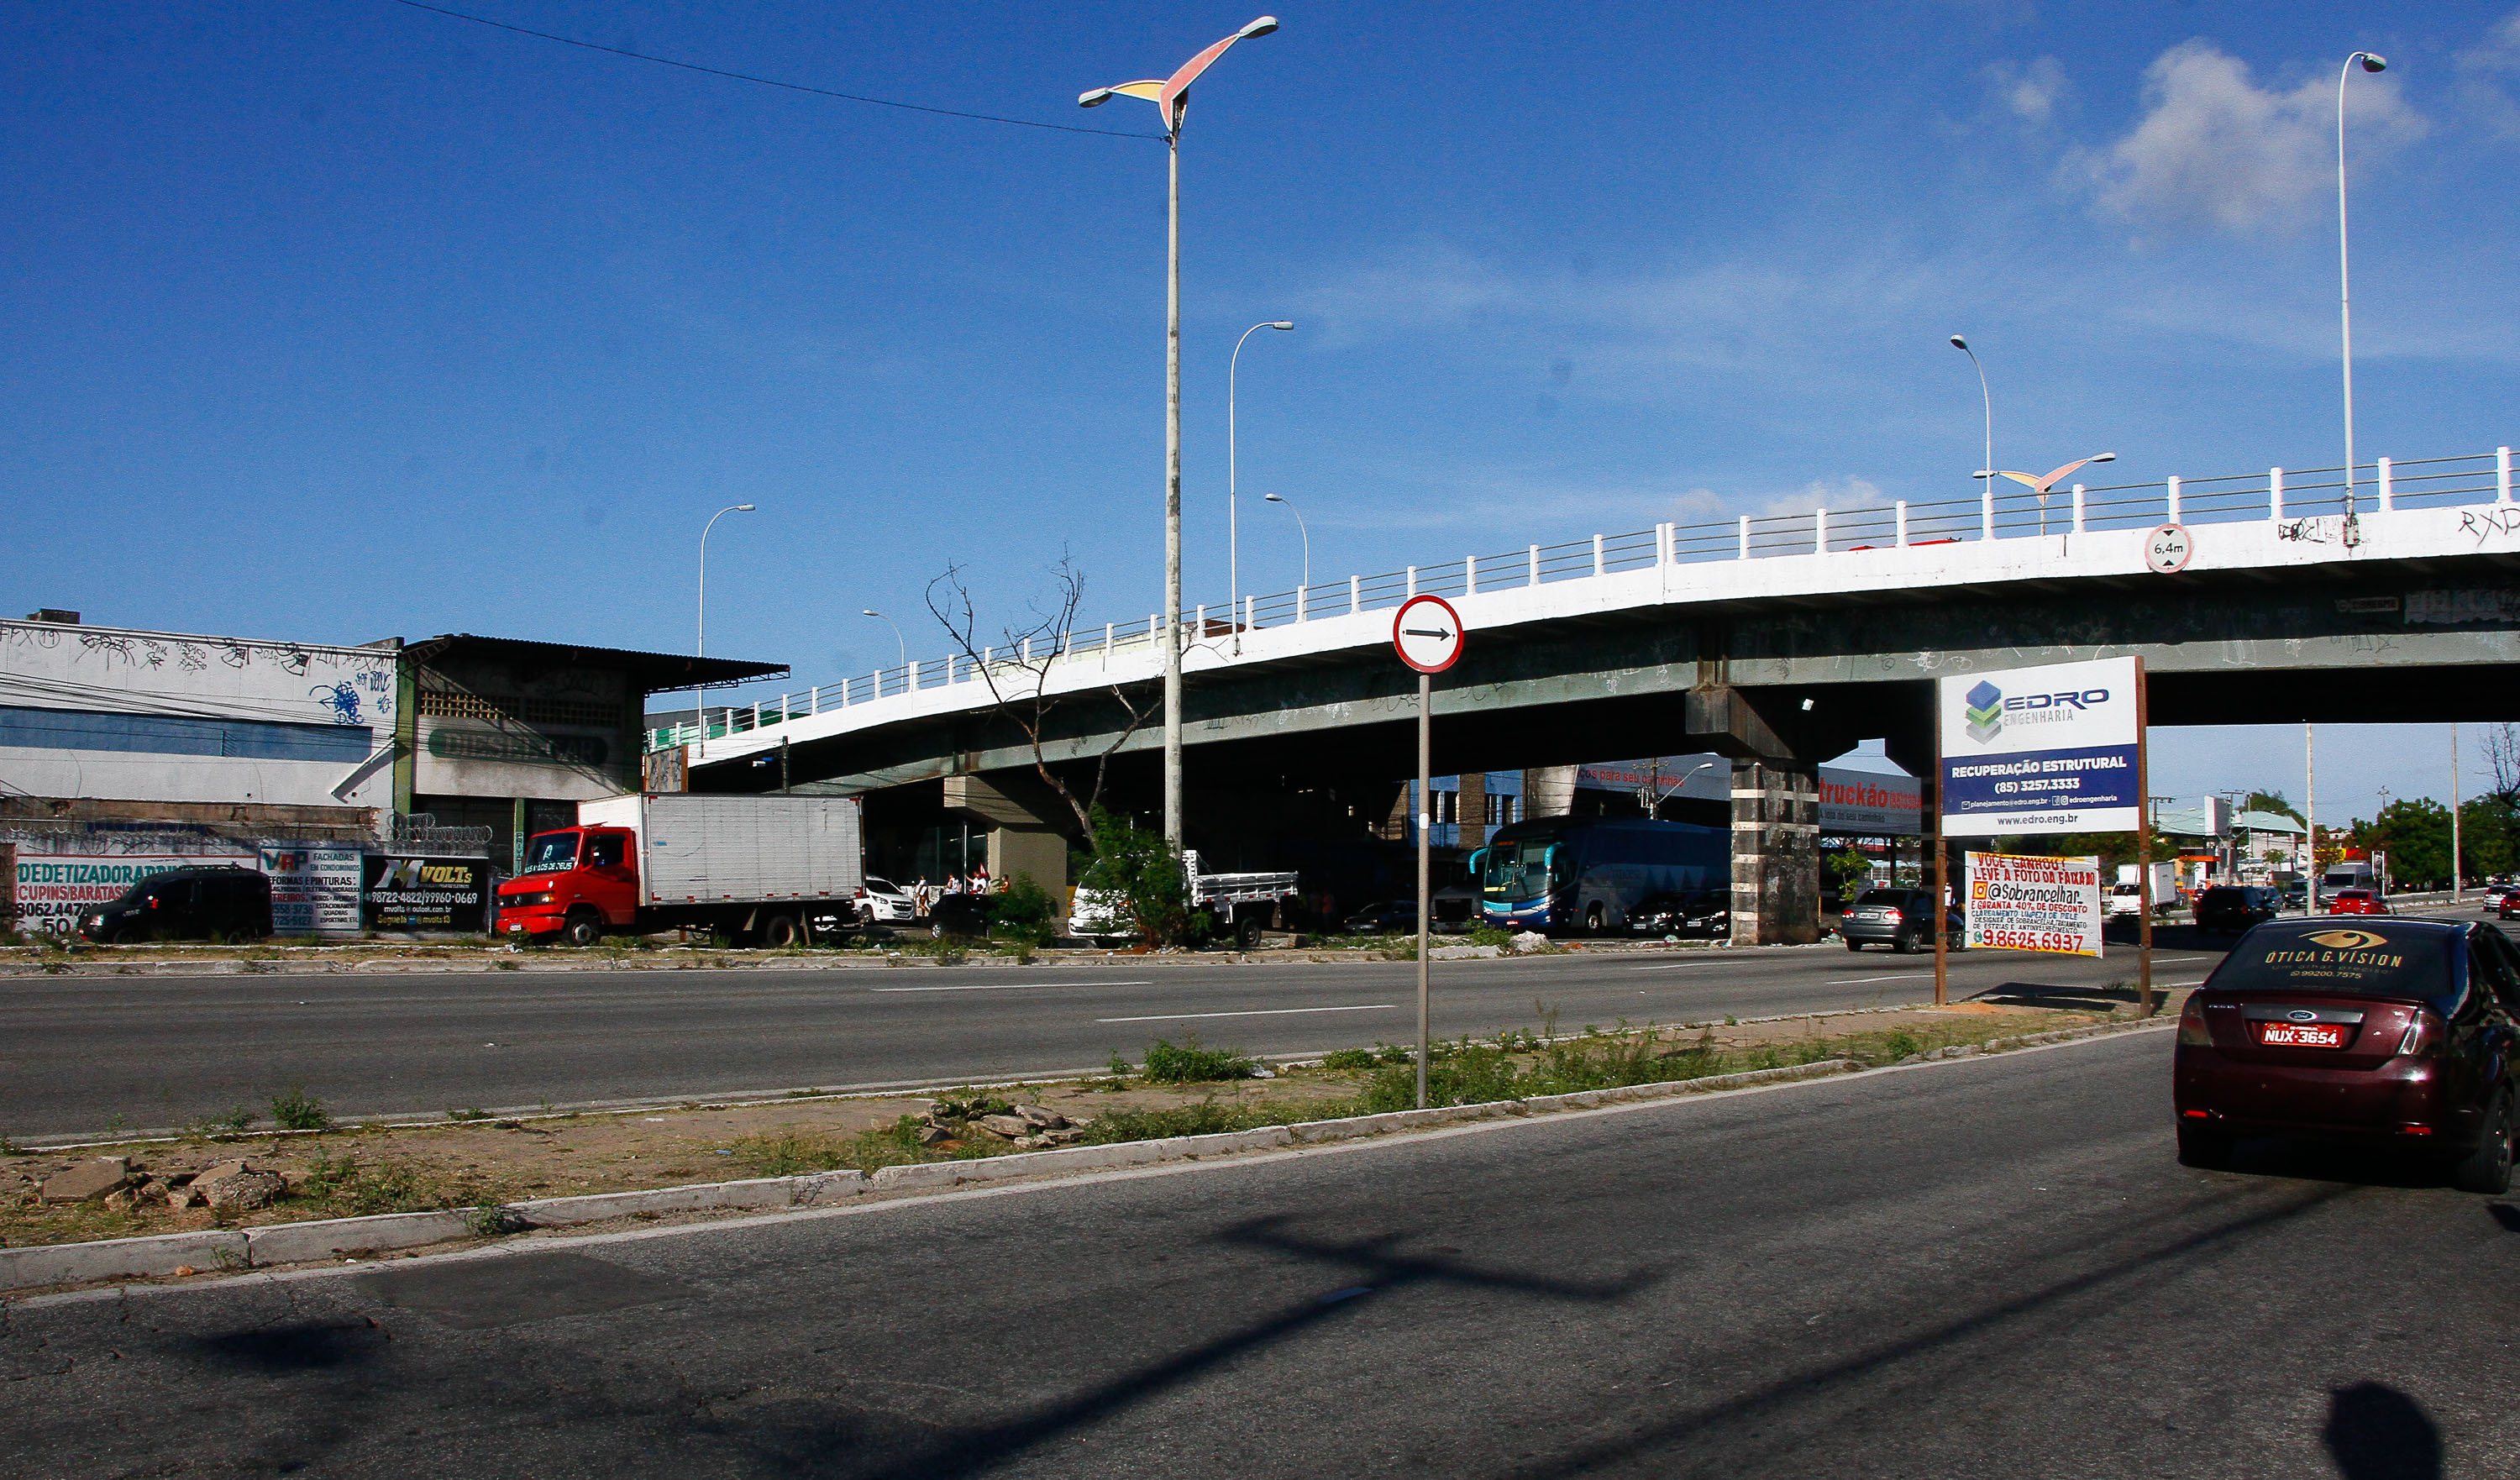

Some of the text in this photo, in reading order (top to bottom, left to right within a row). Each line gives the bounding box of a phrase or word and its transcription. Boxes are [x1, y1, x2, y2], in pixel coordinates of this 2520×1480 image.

[2155, 543, 2183, 555] 6,4m
[2003, 689, 2109, 711] EDRO
[2003, 708, 2074, 727] ENGENHARIA
[1951, 755, 2128, 779] RECUPERAÇÃO ESTRUTURAL
[1623, 773, 1640, 784] seu
[1819, 777, 1888, 808] truckão
[1994, 778, 2081, 795] (85) 3257.3333
[1970, 794, 2118, 808] planejamento@edro.eng.br edroengenharia
[1997, 813, 2078, 826] www.edro.eng.br
[269, 876, 302, 885] EFORMAS
[1973, 868, 2000, 881] LEVE
[2004, 869, 2011, 881] A
[2014, 869, 2040, 883] FOTO
[2042, 872, 2055, 884] DA
[1977, 900, 2012, 910] GARANTA
[2015, 901, 2034, 911] 40%
[2037, 903, 2047, 911] DE
[2049, 904, 2087, 913] DESCONTO
[1982, 929, 2083, 953] 9.8625.6937
[2265, 950, 2317, 964] ÓTICA
